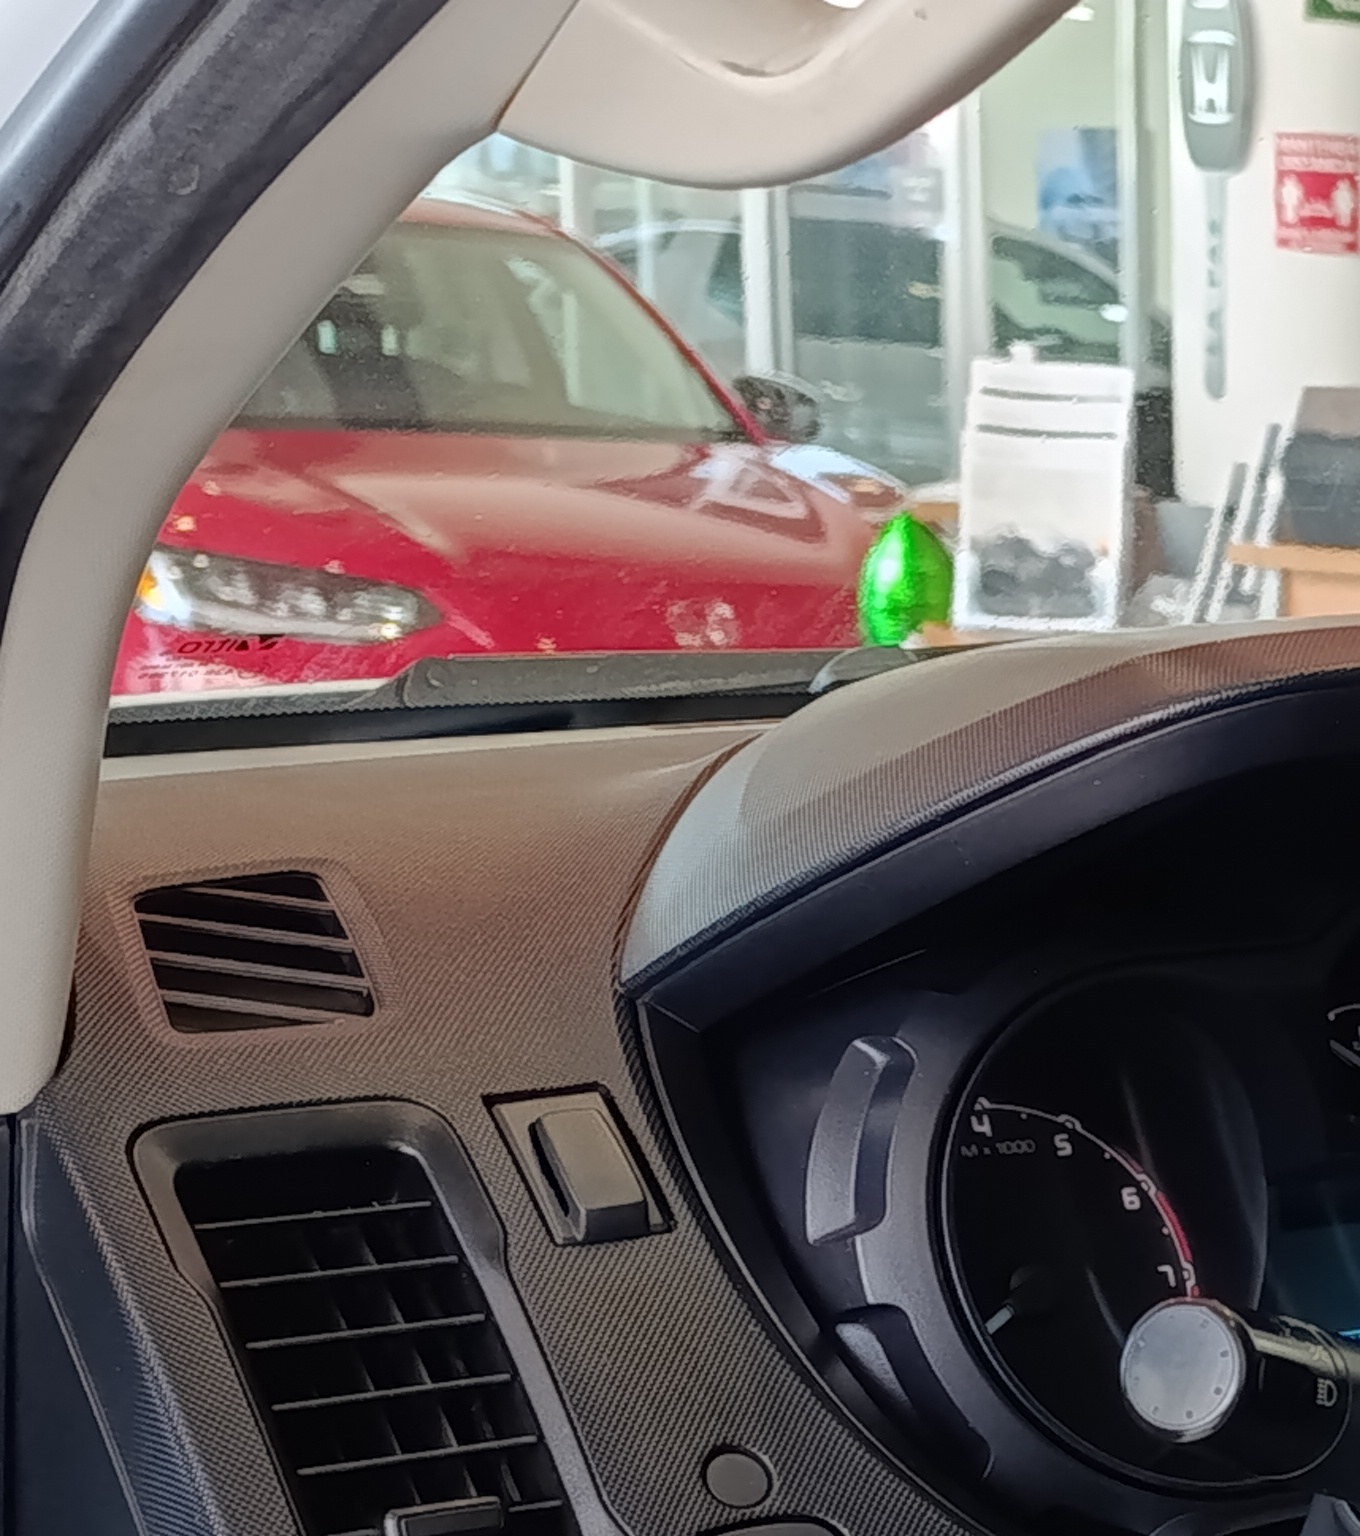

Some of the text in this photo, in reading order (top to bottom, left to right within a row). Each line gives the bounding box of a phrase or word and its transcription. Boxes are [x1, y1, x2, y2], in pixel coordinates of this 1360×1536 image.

[970, 1113, 993, 1137] 4
[995, 1139, 1036, 1155] 1000
[1053, 1133, 1073, 1157] 5
[1120, 1186, 1141, 1211] 6
[1156, 1264, 1177, 1288] 7
